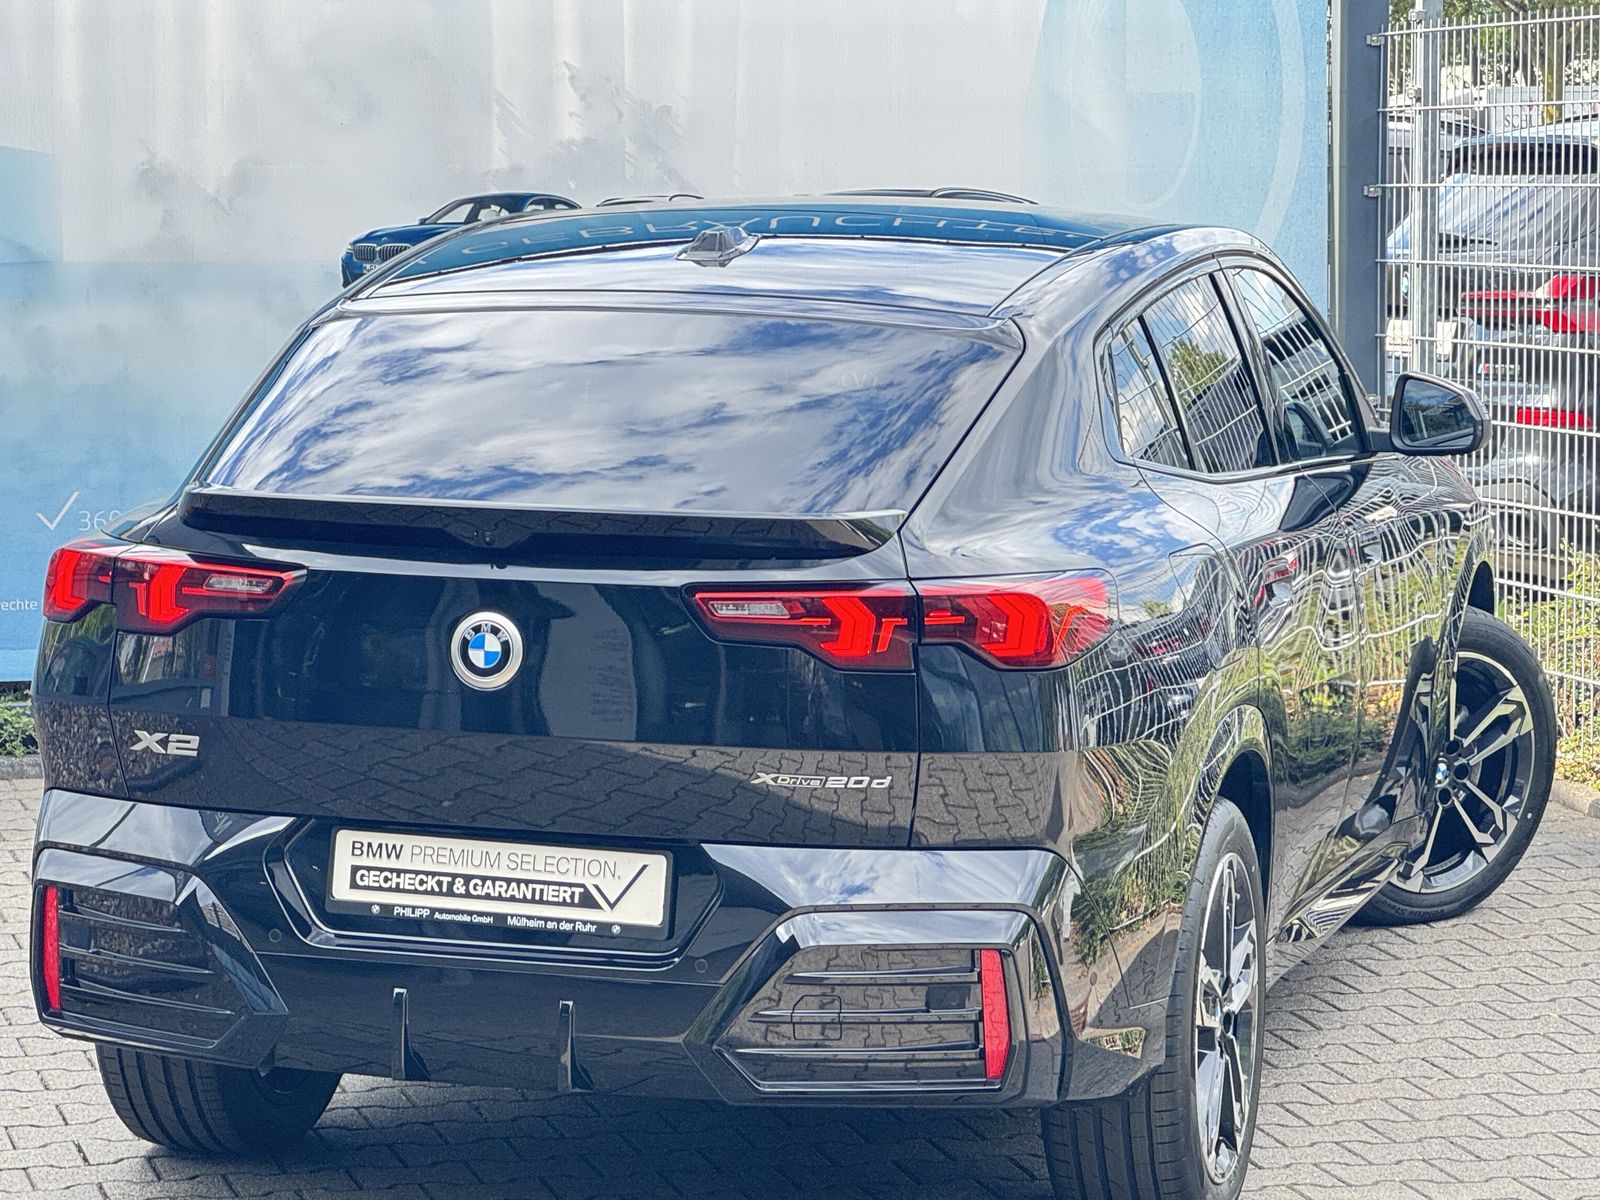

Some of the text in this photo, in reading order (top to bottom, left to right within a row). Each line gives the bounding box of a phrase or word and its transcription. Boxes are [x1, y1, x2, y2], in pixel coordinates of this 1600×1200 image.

[0, 598, 38, 611] echte
[464, 622, 509, 642] BMW
[129, 729, 200, 757] X2
[351, 840, 621, 880] BMW PREMIUM SELECTION.
[355, 869, 585, 904] GECHECKT & GARANTIERT
[393, 906, 494, 924] PHILIPP Automobile GmbH
[507, 915, 598, 933] Mülheim an der Ruhr
